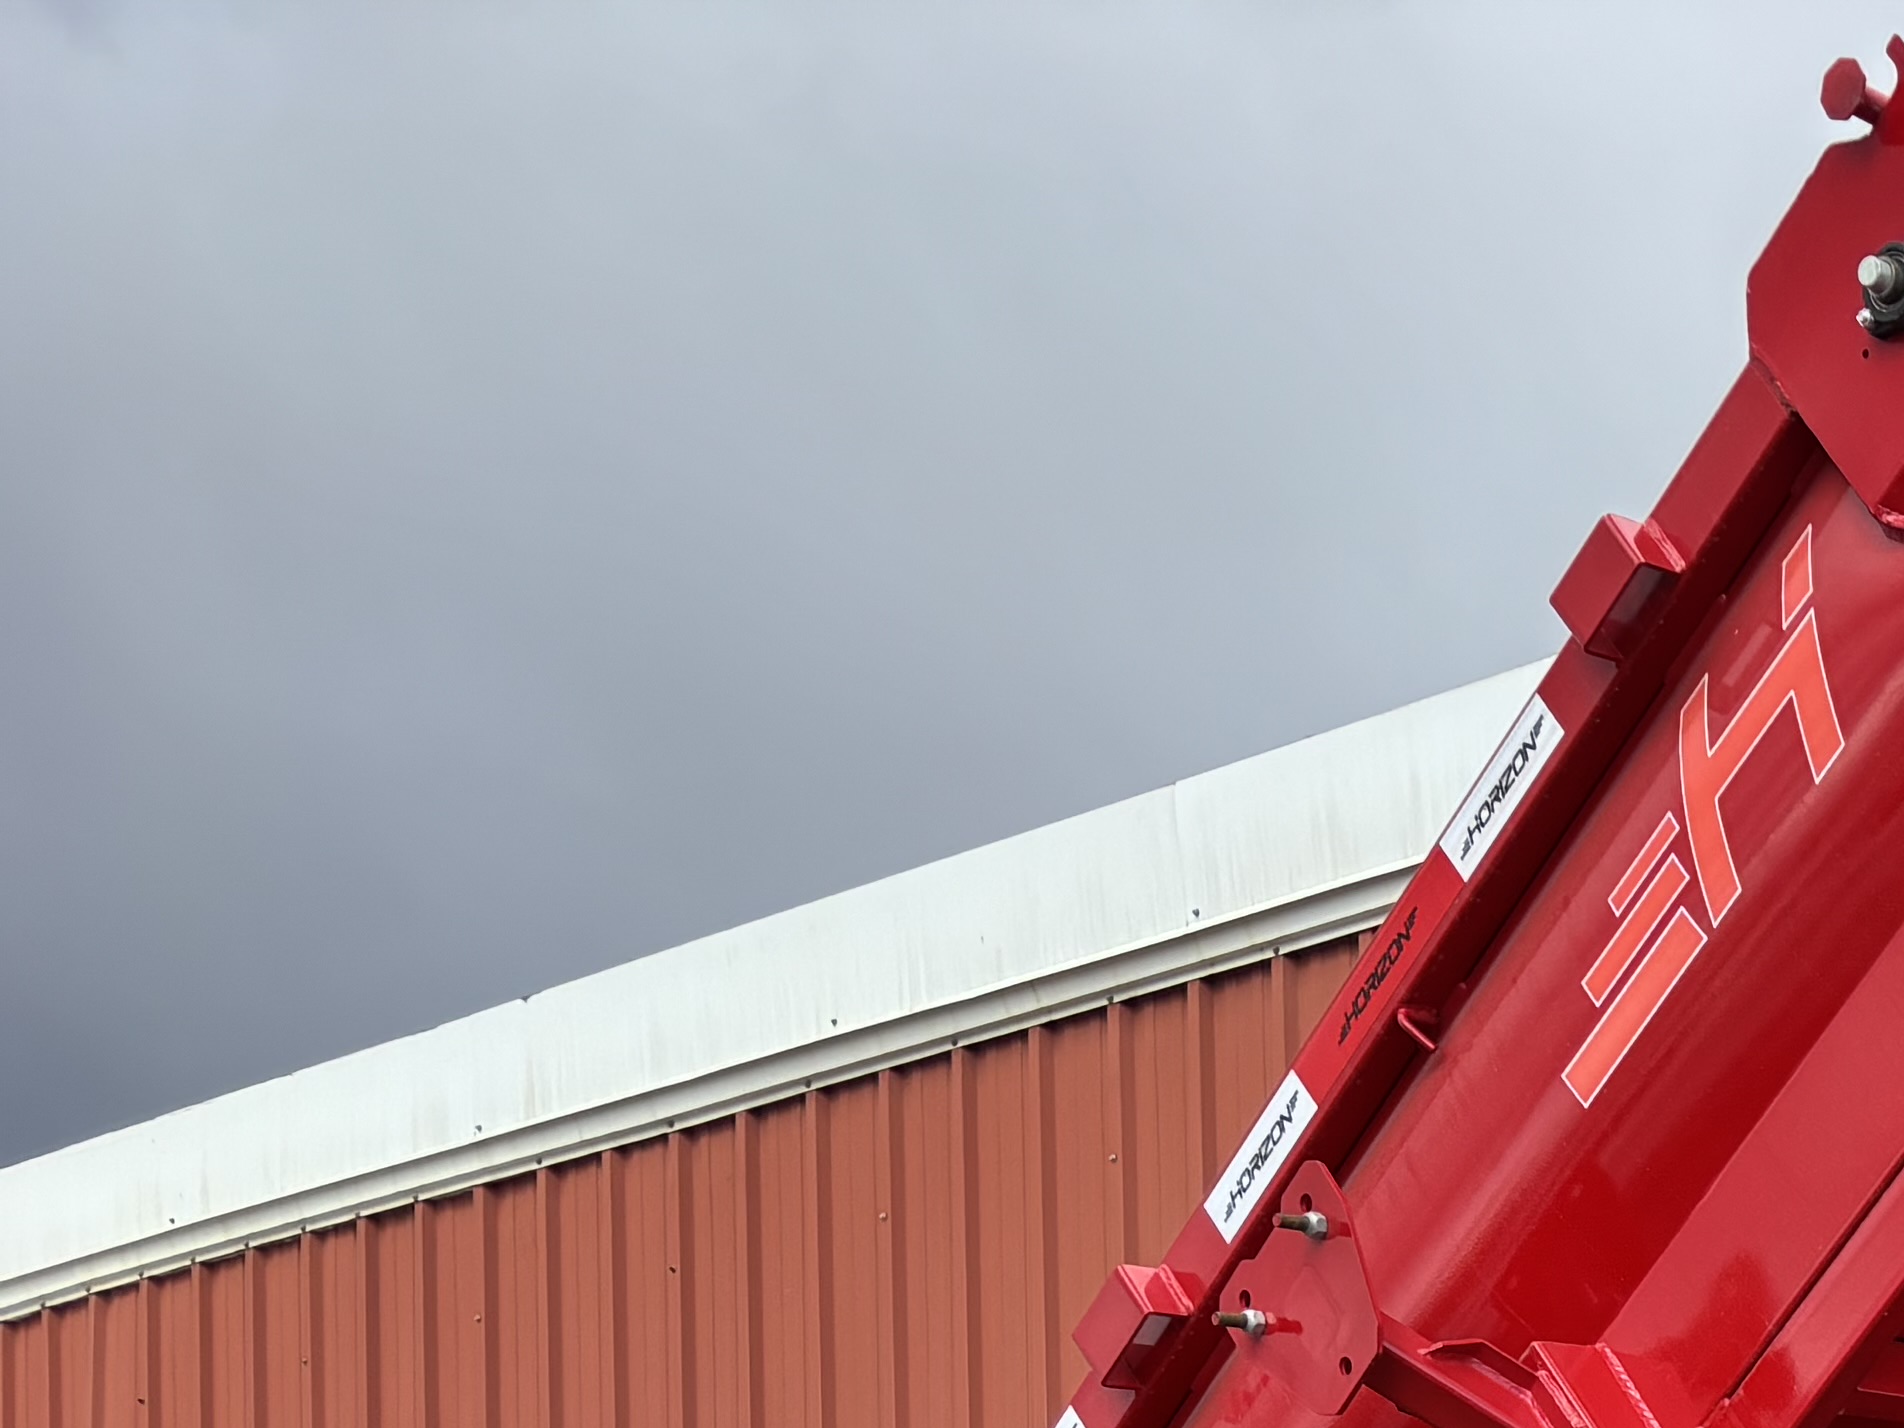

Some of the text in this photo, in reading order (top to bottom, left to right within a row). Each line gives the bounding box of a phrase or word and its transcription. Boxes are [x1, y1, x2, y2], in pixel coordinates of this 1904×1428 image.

[1466, 727, 1537, 848] HORIZON
[1343, 917, 1412, 1036] HORIZON
[1231, 1100, 1293, 1212] HORIZON
